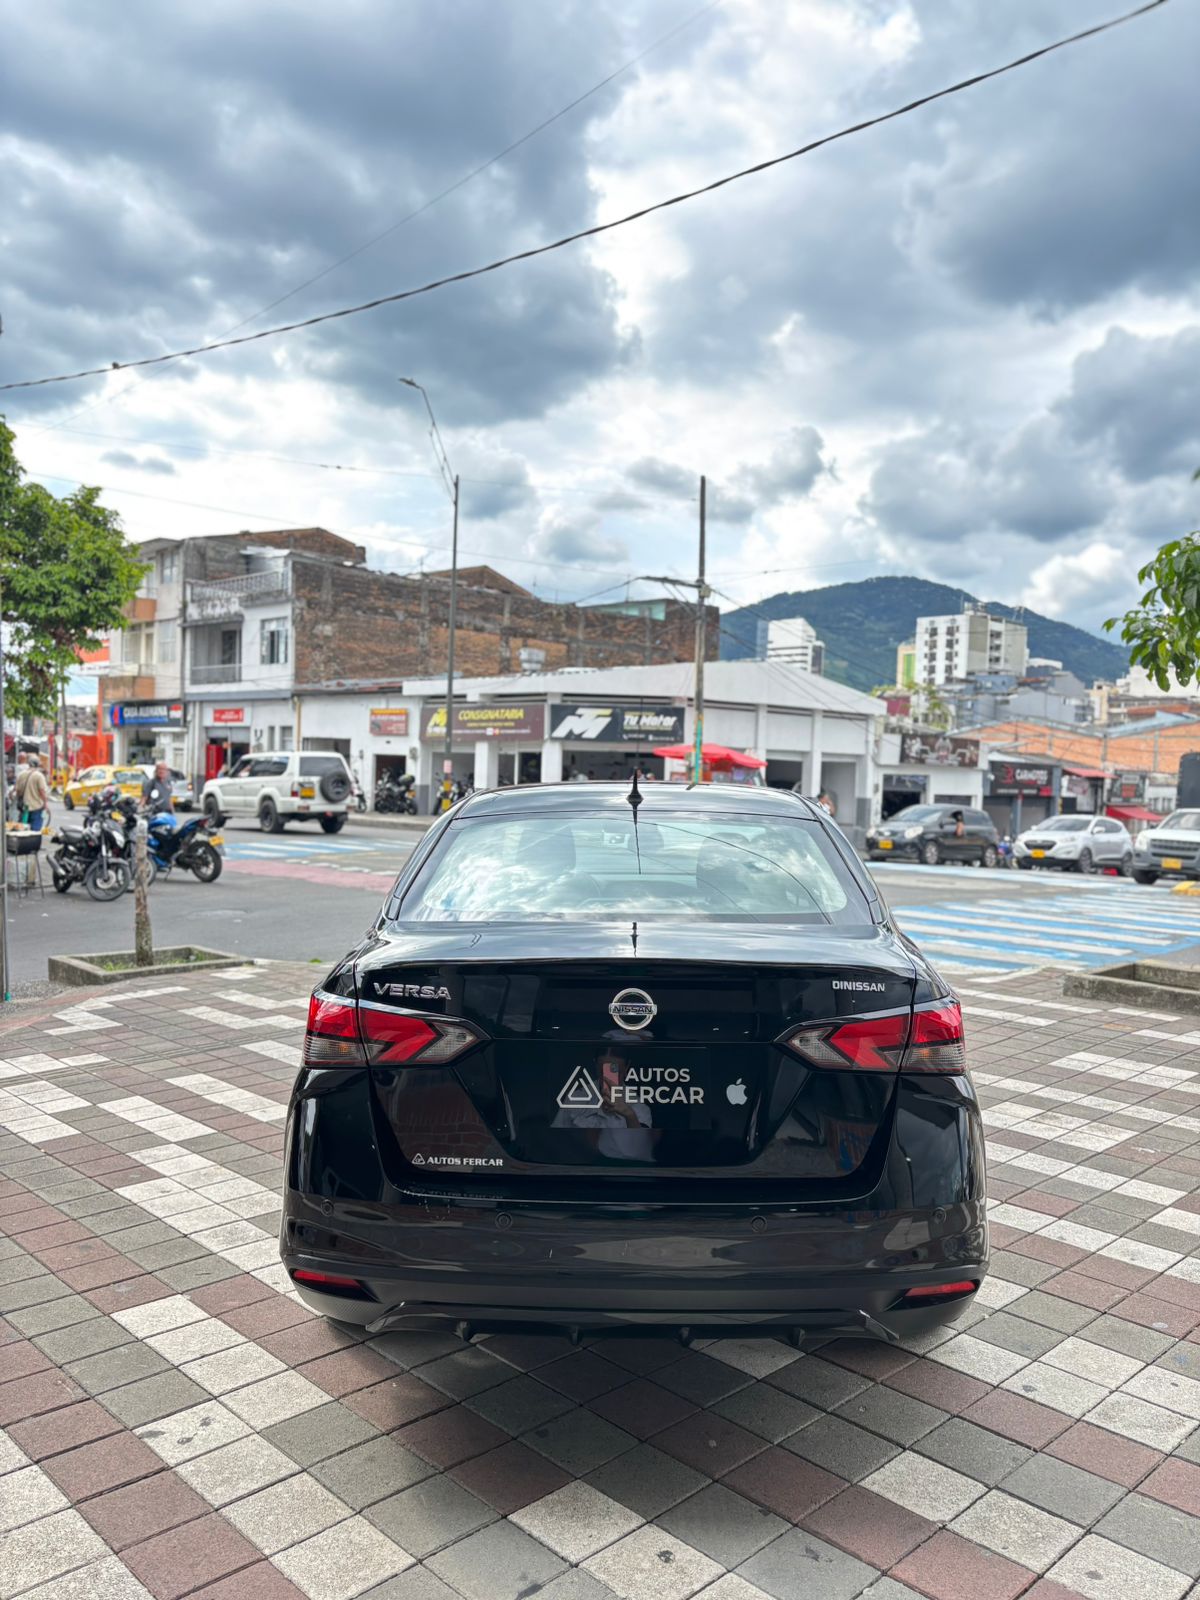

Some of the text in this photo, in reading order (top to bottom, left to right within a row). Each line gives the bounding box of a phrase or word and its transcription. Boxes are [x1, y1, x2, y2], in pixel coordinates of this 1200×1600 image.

[458, 708, 524, 721] CONSIGNATARIA
[373, 982, 451, 1000] VERSA
[832, 980, 886, 992] DINISSAN
[612, 1005, 653, 1014] NISSAN
[624, 1067, 691, 1083] AUTOS
[610, 1086, 705, 1104] FERCAR
[427, 1156, 504, 1167] AUTOS FERCAR
